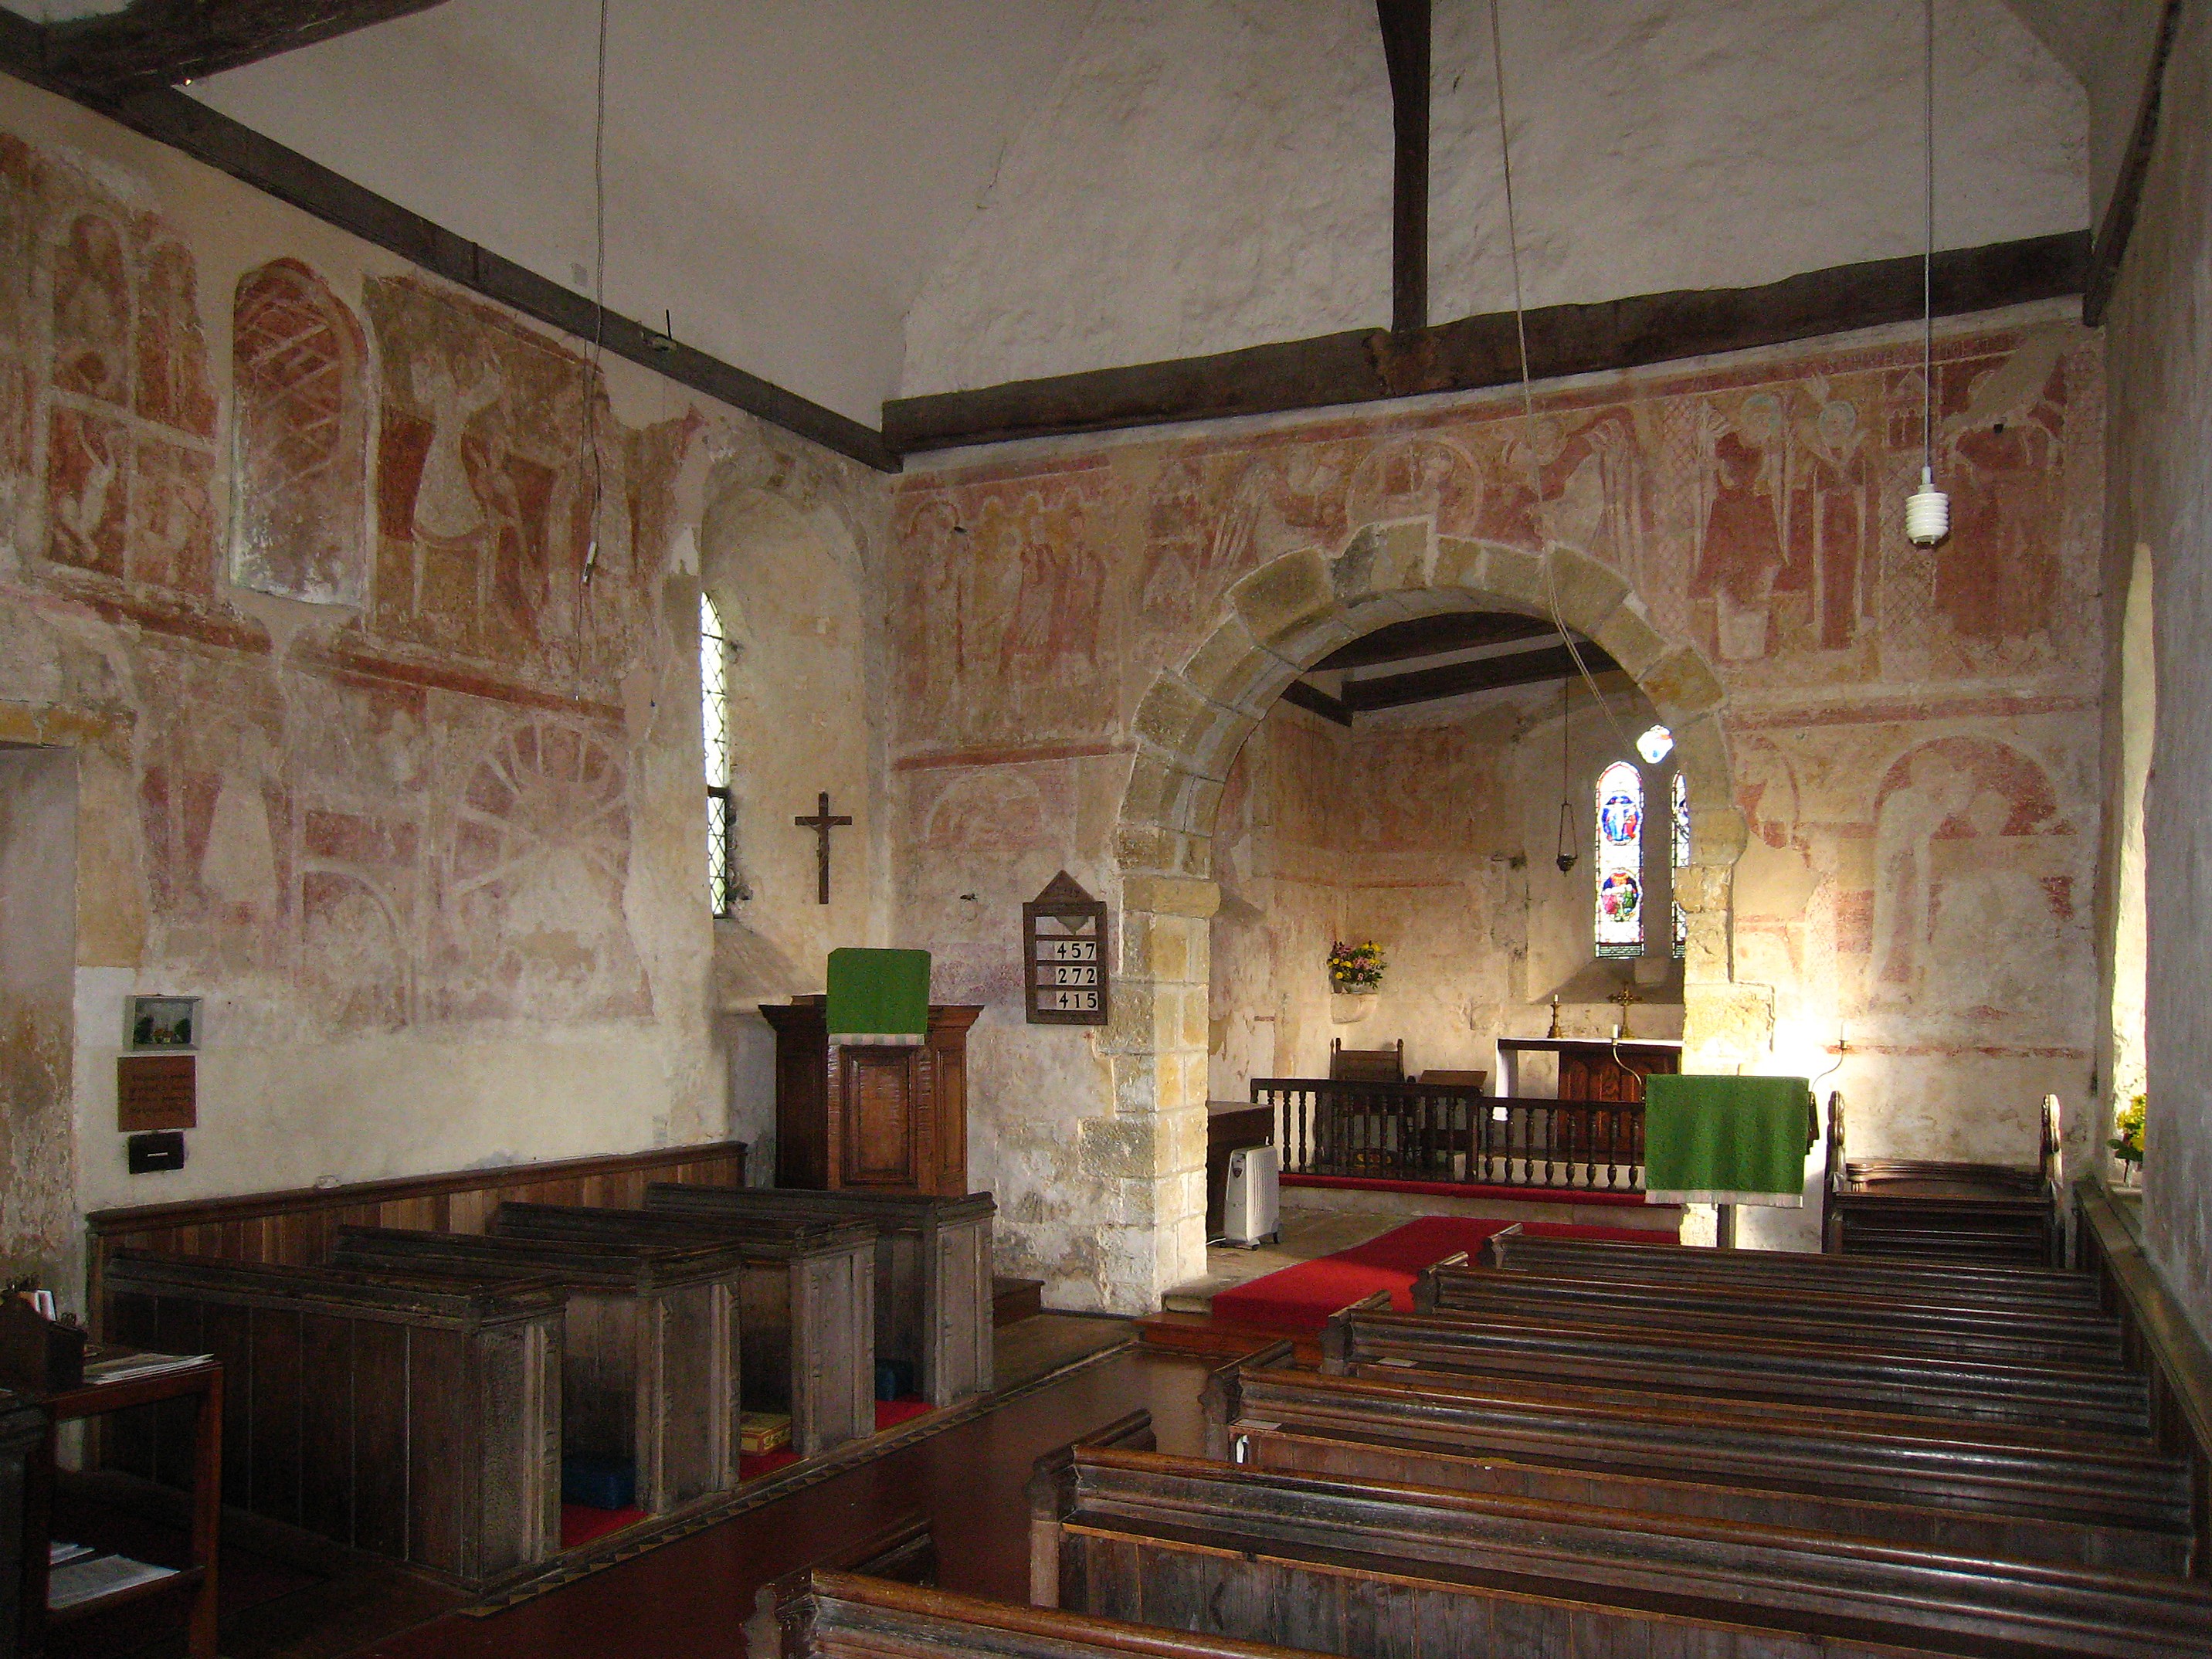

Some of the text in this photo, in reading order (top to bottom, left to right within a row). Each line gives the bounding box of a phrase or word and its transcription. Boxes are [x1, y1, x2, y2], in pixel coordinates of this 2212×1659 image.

[1057, 941, 1095, 959] 457
[1057, 968, 1095, 985] 272
[1058, 992, 1097, 1009] 415
